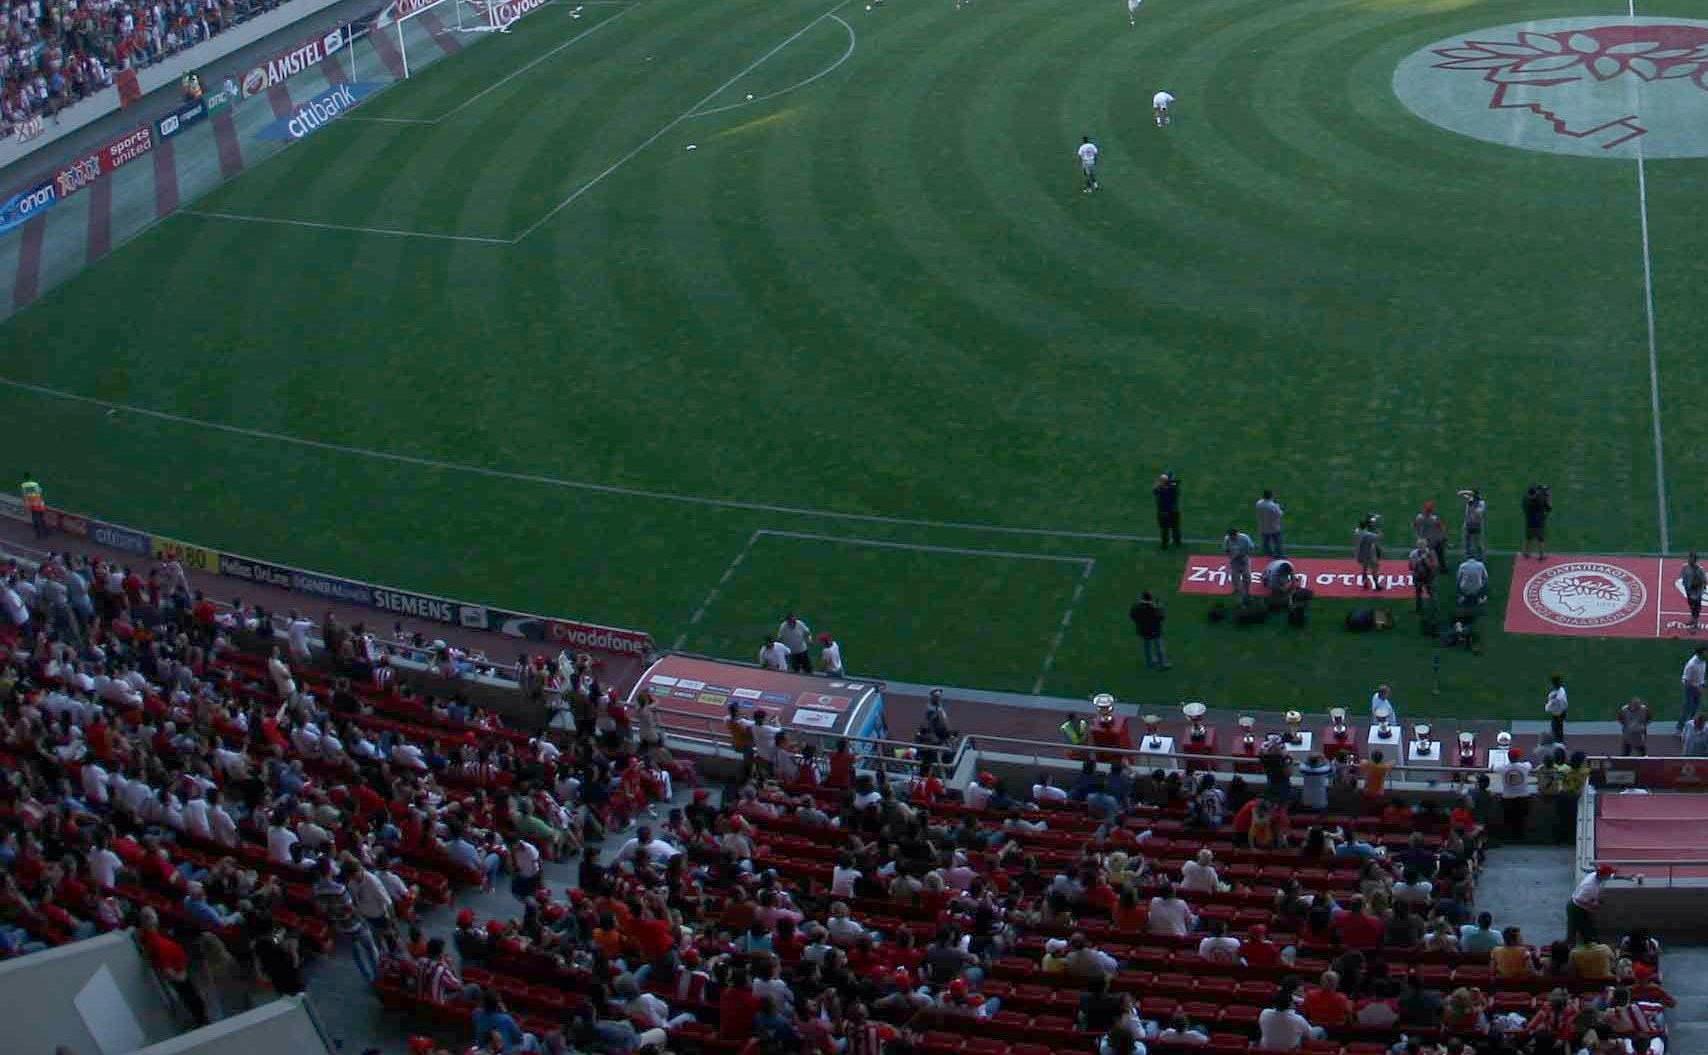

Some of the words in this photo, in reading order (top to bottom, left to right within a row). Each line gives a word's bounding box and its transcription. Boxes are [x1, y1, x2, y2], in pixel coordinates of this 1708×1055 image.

[267, 42, 322, 86] AMSTEL
[289, 84, 356, 138] citibank
[110, 129, 150, 155] sports
[112, 141, 151, 167] united
[1187, 565, 1263, 587] Ζήε
[375, 591, 451, 621] SIEMENS
[567, 630, 642, 655] vodafone
